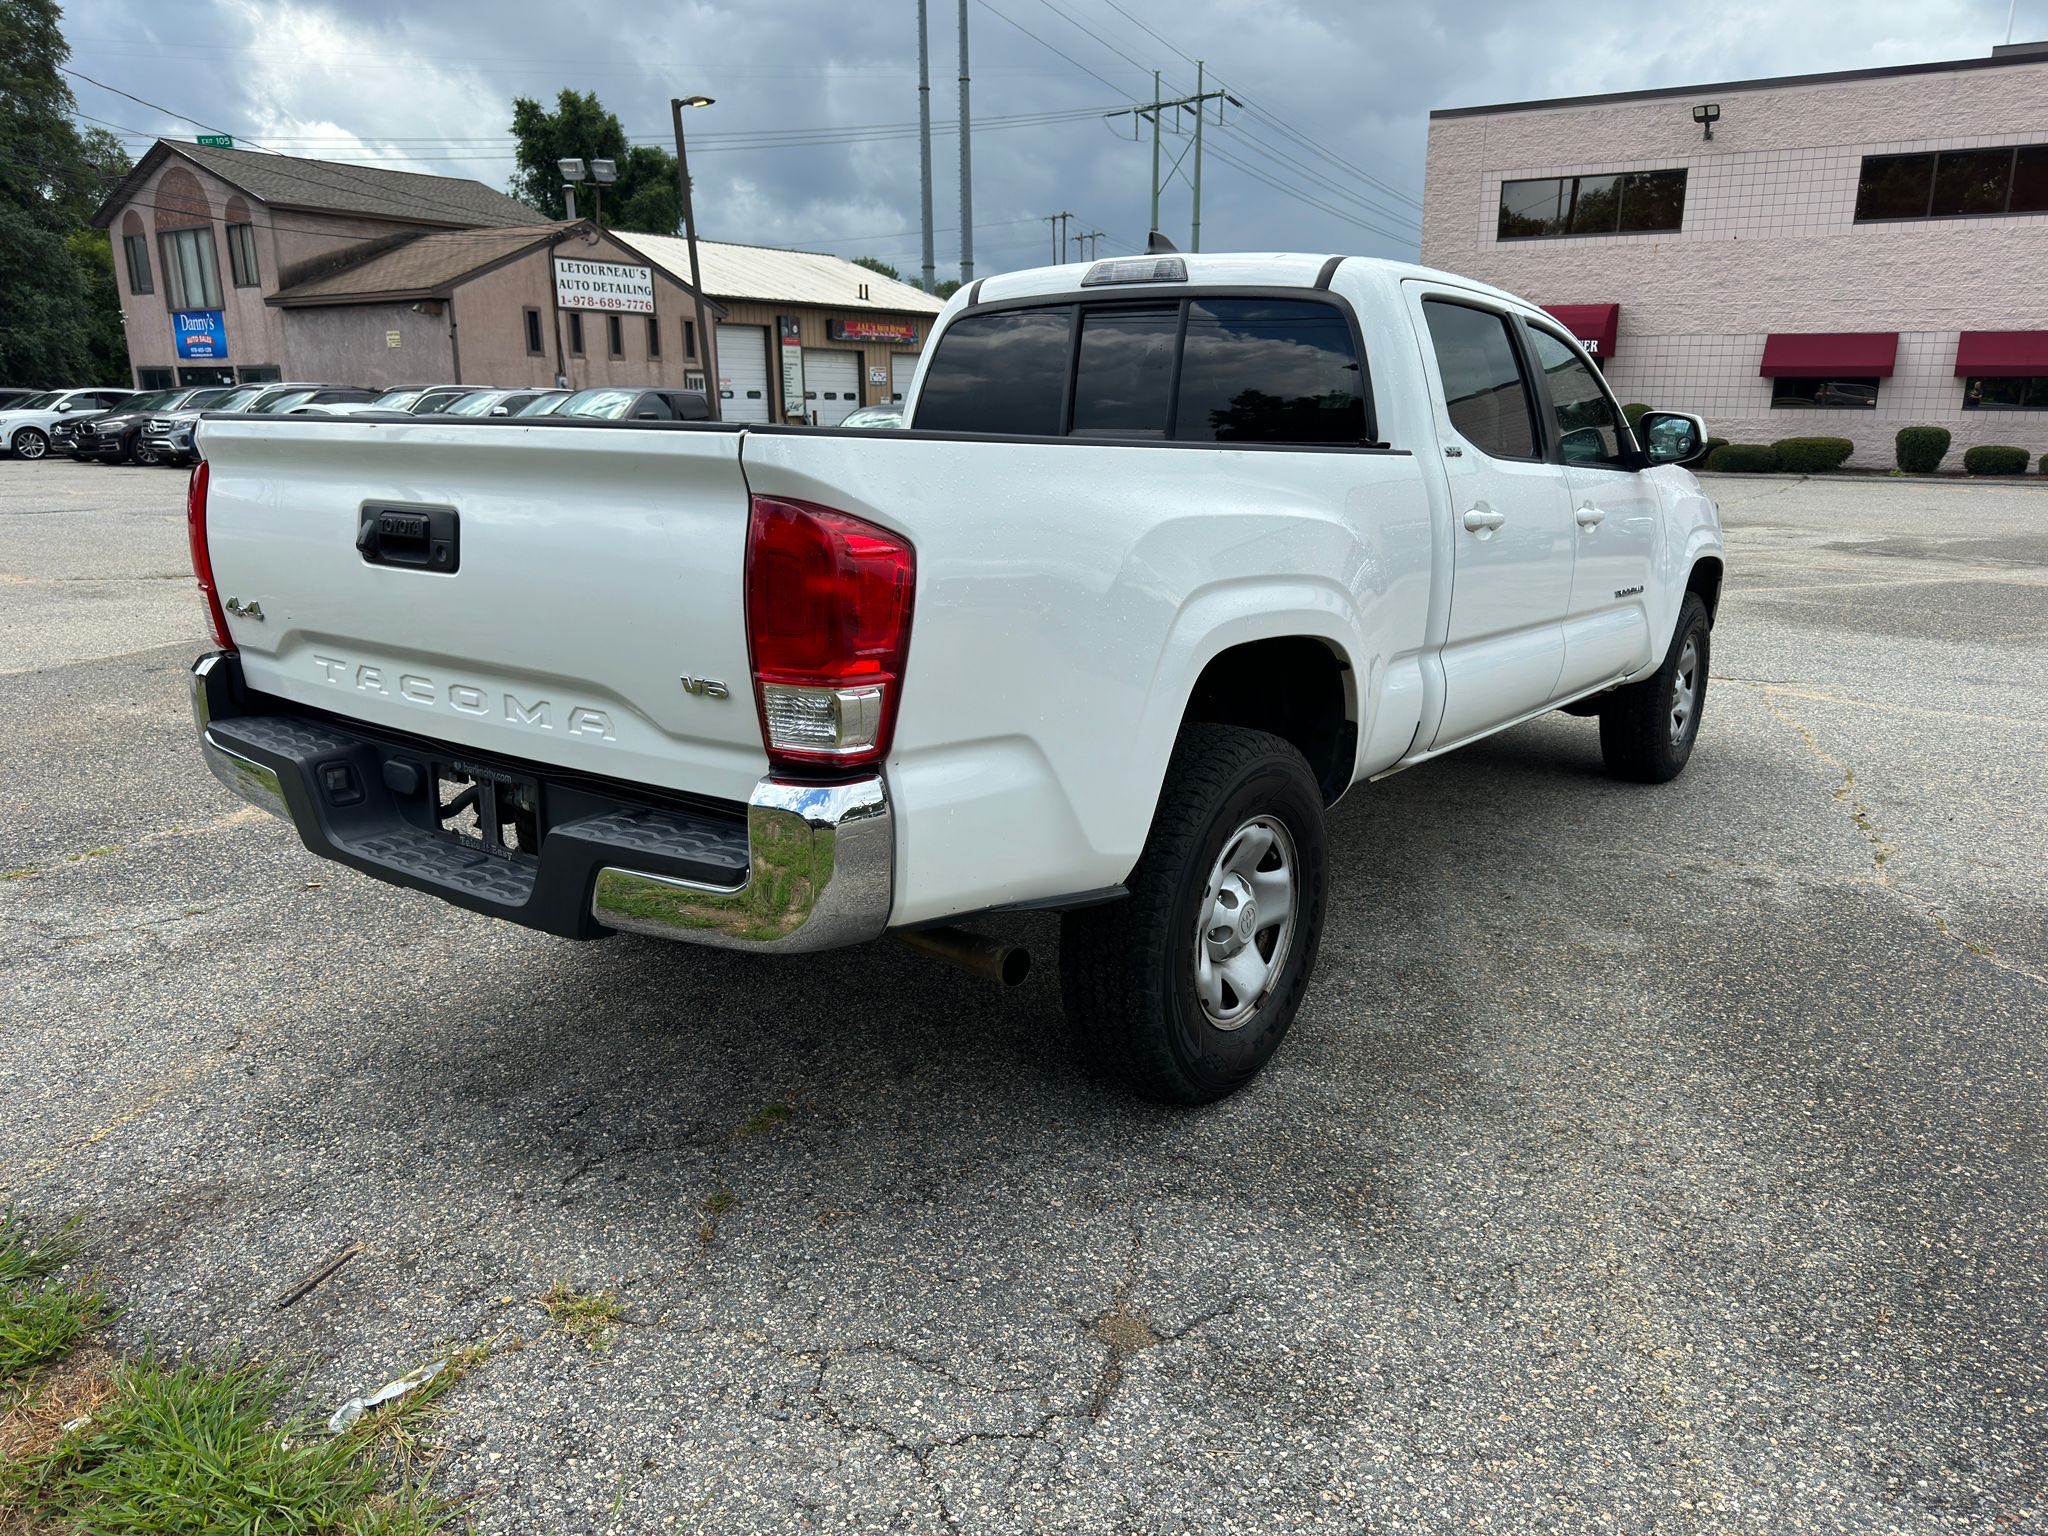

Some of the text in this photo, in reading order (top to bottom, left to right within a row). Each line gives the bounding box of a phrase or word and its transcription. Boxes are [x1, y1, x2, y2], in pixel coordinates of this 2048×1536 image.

[216, 137, 230, 145] 105
[560, 262, 647, 280] LETOURNEAU'S
[559, 279, 652, 296] AUTO DETAILING
[561, 295, 652, 311] 1-978-689-7776
[180, 313, 214, 335] Danny's
[380, 518, 421, 536] TOYOTA
[680, 675, 729, 699] V6
[313, 654, 617, 741] TACOMA
